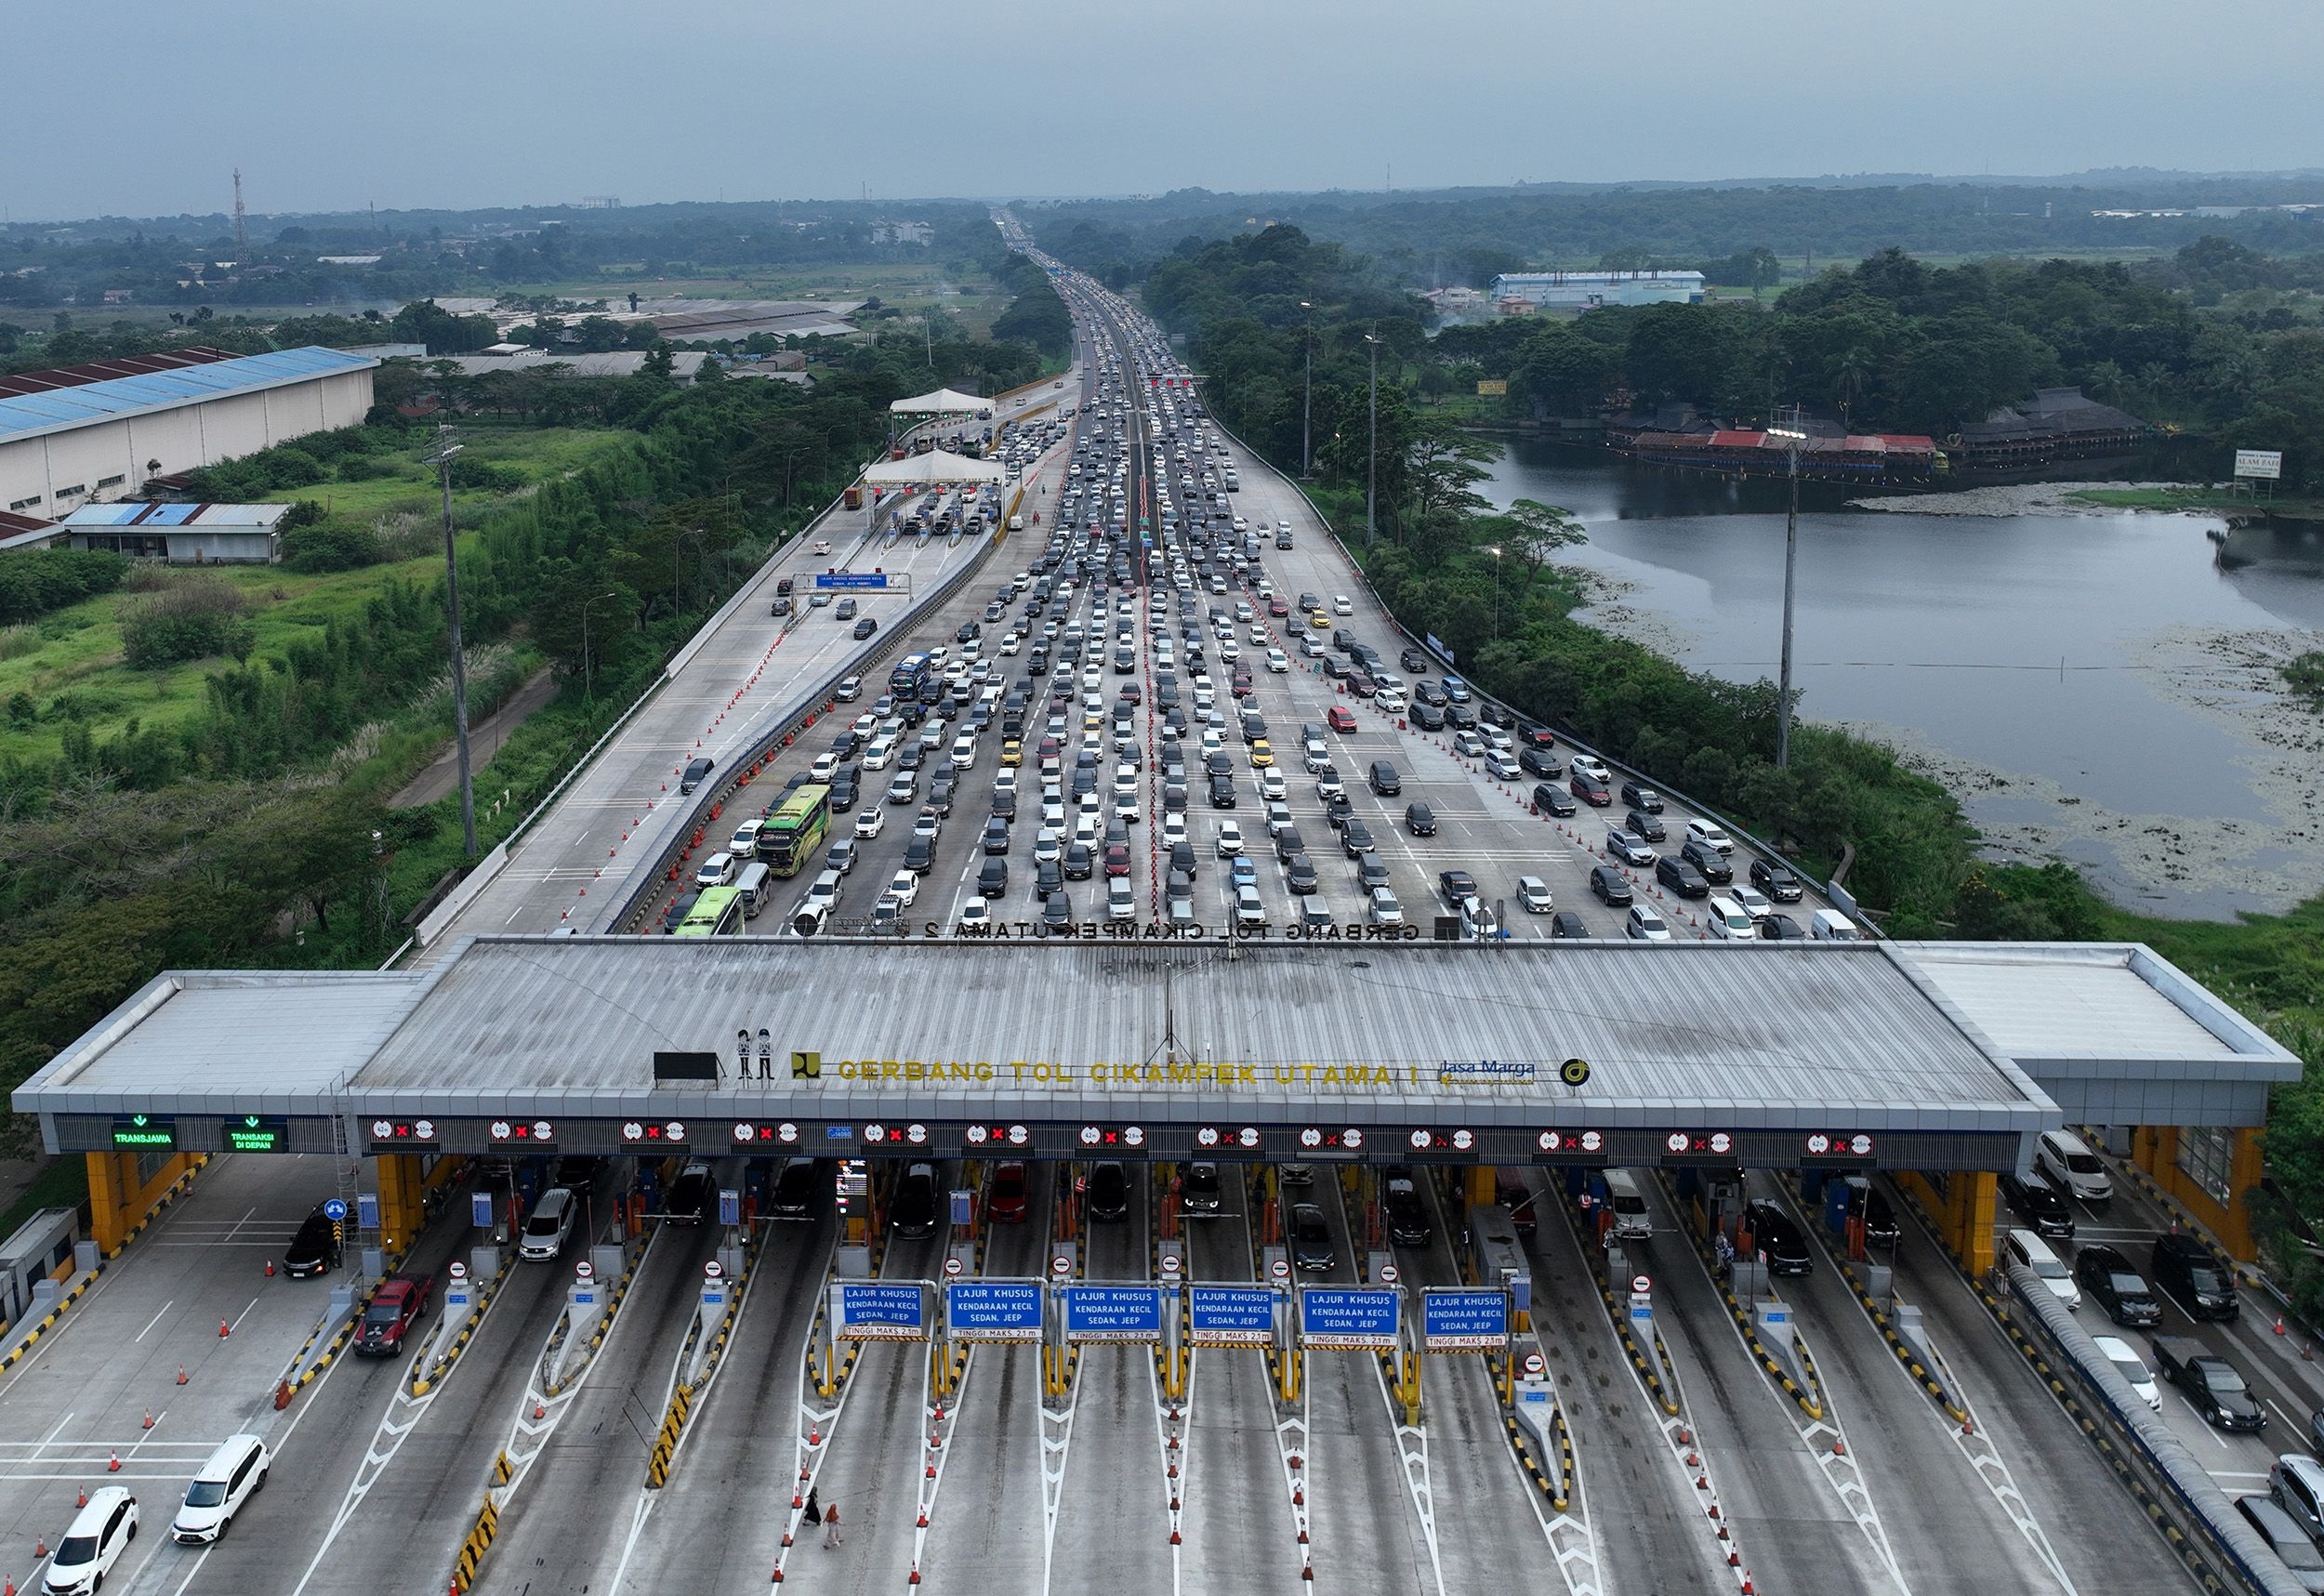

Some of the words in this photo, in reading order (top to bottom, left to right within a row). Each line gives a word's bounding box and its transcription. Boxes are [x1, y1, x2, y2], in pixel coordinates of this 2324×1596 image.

[838, 1060, 993, 1082] GERBANG
[1010, 1061, 1074, 1082] TOL
[1090, 1062, 1257, 1085] CIKAMPEK
[1274, 1064, 1392, 1086] UTAMA
[1442, 1060, 1475, 1074] Jasa
[1482, 1060, 1535, 1077] Marga
[114, 1134, 171, 1143] TRANSJAWA
[231, 1133, 274, 1141] TRANSAKSI
[882, 1290, 918, 1299] KHUSUS
[957, 1289, 987, 1298] LAJUR
[995, 1289, 1034, 1298] KHUSUS
[1076, 1292, 1105, 1300] LAJUR
[1113, 1292, 1153, 1300] KHUSUS
[1196, 1292, 1226, 1301] LAJUR
[1231, 1293, 1269, 1302] KHUSUS
[1312, 1296, 1343, 1304] LAJUR
[1350, 1296, 1391, 1305] KHUSUS
[1429, 1298, 1459, 1307] LAJUR
[1464, 1297, 1502, 1306] KHUSUS
[847, 1301, 894, 1310] KENDARAAN
[897, 1302, 918, 1311] KECIL
[957, 1302, 1007, 1311] KENDARAAN
[1011, 1302, 1034, 1311] KECIL
[1076, 1305, 1126, 1313] KENDARAAN
[1129, 1305, 1152, 1313] KECIL
[1195, 1304, 1245, 1313] KENDARAAN
[891, 1312, 909, 1321] JEEP
[1003, 1313, 1023, 1322] JEEP
[1367, 1309, 1390, 1317] KECIL
[1429, 1310, 1477, 1318] KENDARAAN
[1481, 1310, 1503, 1318] KECIL
[1239, 1317, 1259, 1326] JEEP
[1358, 1320, 1378, 1328] JEEP
[1440, 1322, 1470, 1330] SEDAN,
[1472, 1321, 1491, 1330] JEEP
